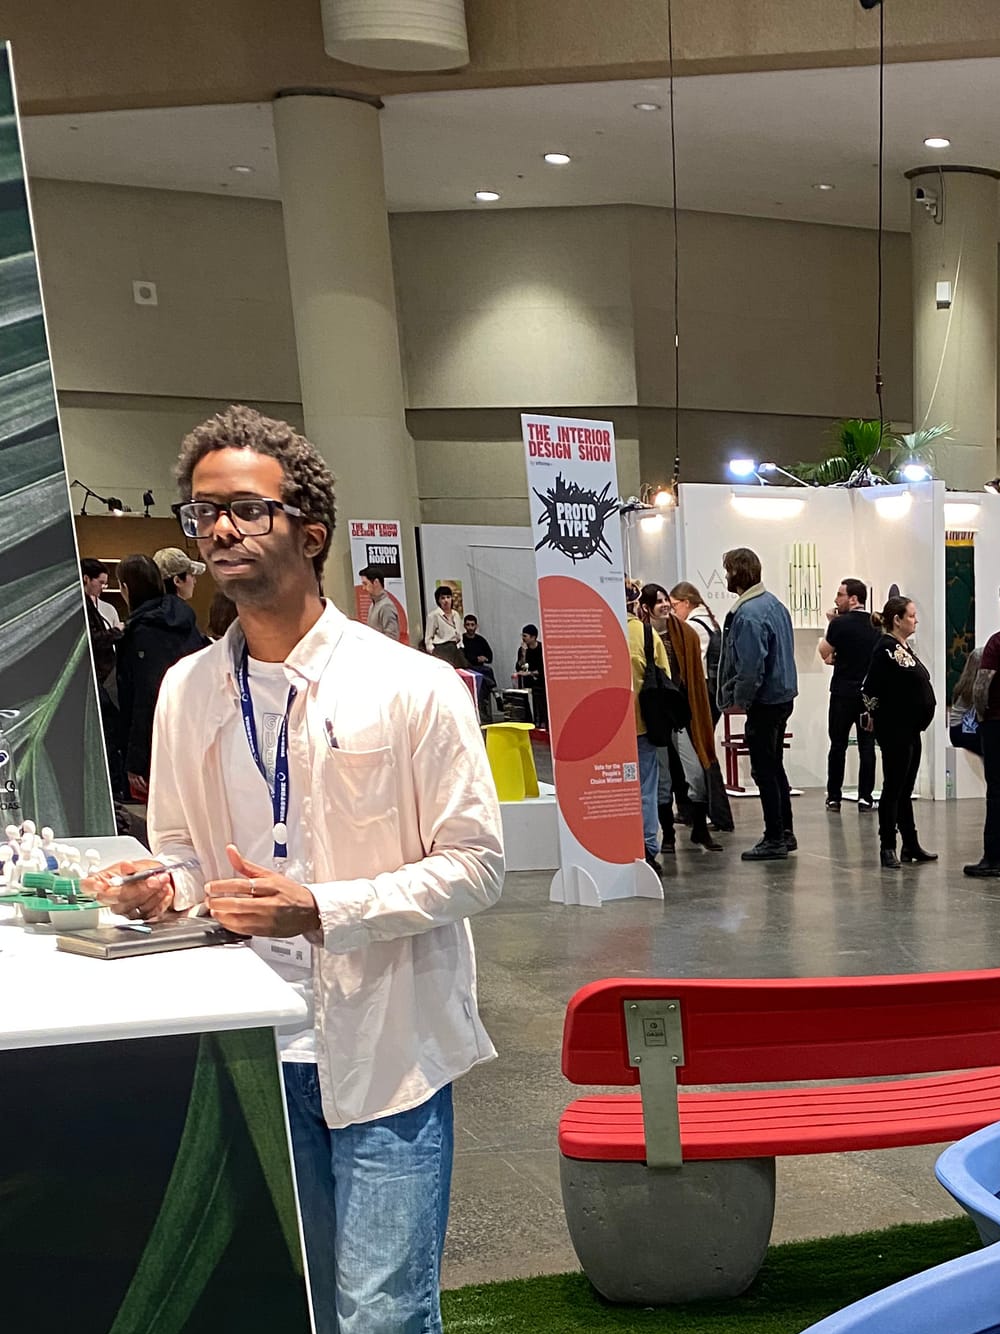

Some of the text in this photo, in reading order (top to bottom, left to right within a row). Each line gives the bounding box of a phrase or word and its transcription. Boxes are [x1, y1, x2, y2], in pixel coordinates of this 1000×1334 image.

[527, 423, 611, 446] THE INTERIOR
[528, 441, 611, 462] DESIGN SHOW
[556, 502, 596, 521] PROTO
[351, 522, 364, 531] THE
[558, 520, 590, 538] TYPE
[368, 546, 397, 556] STUDIO
[369, 554, 397, 564] NORTH
